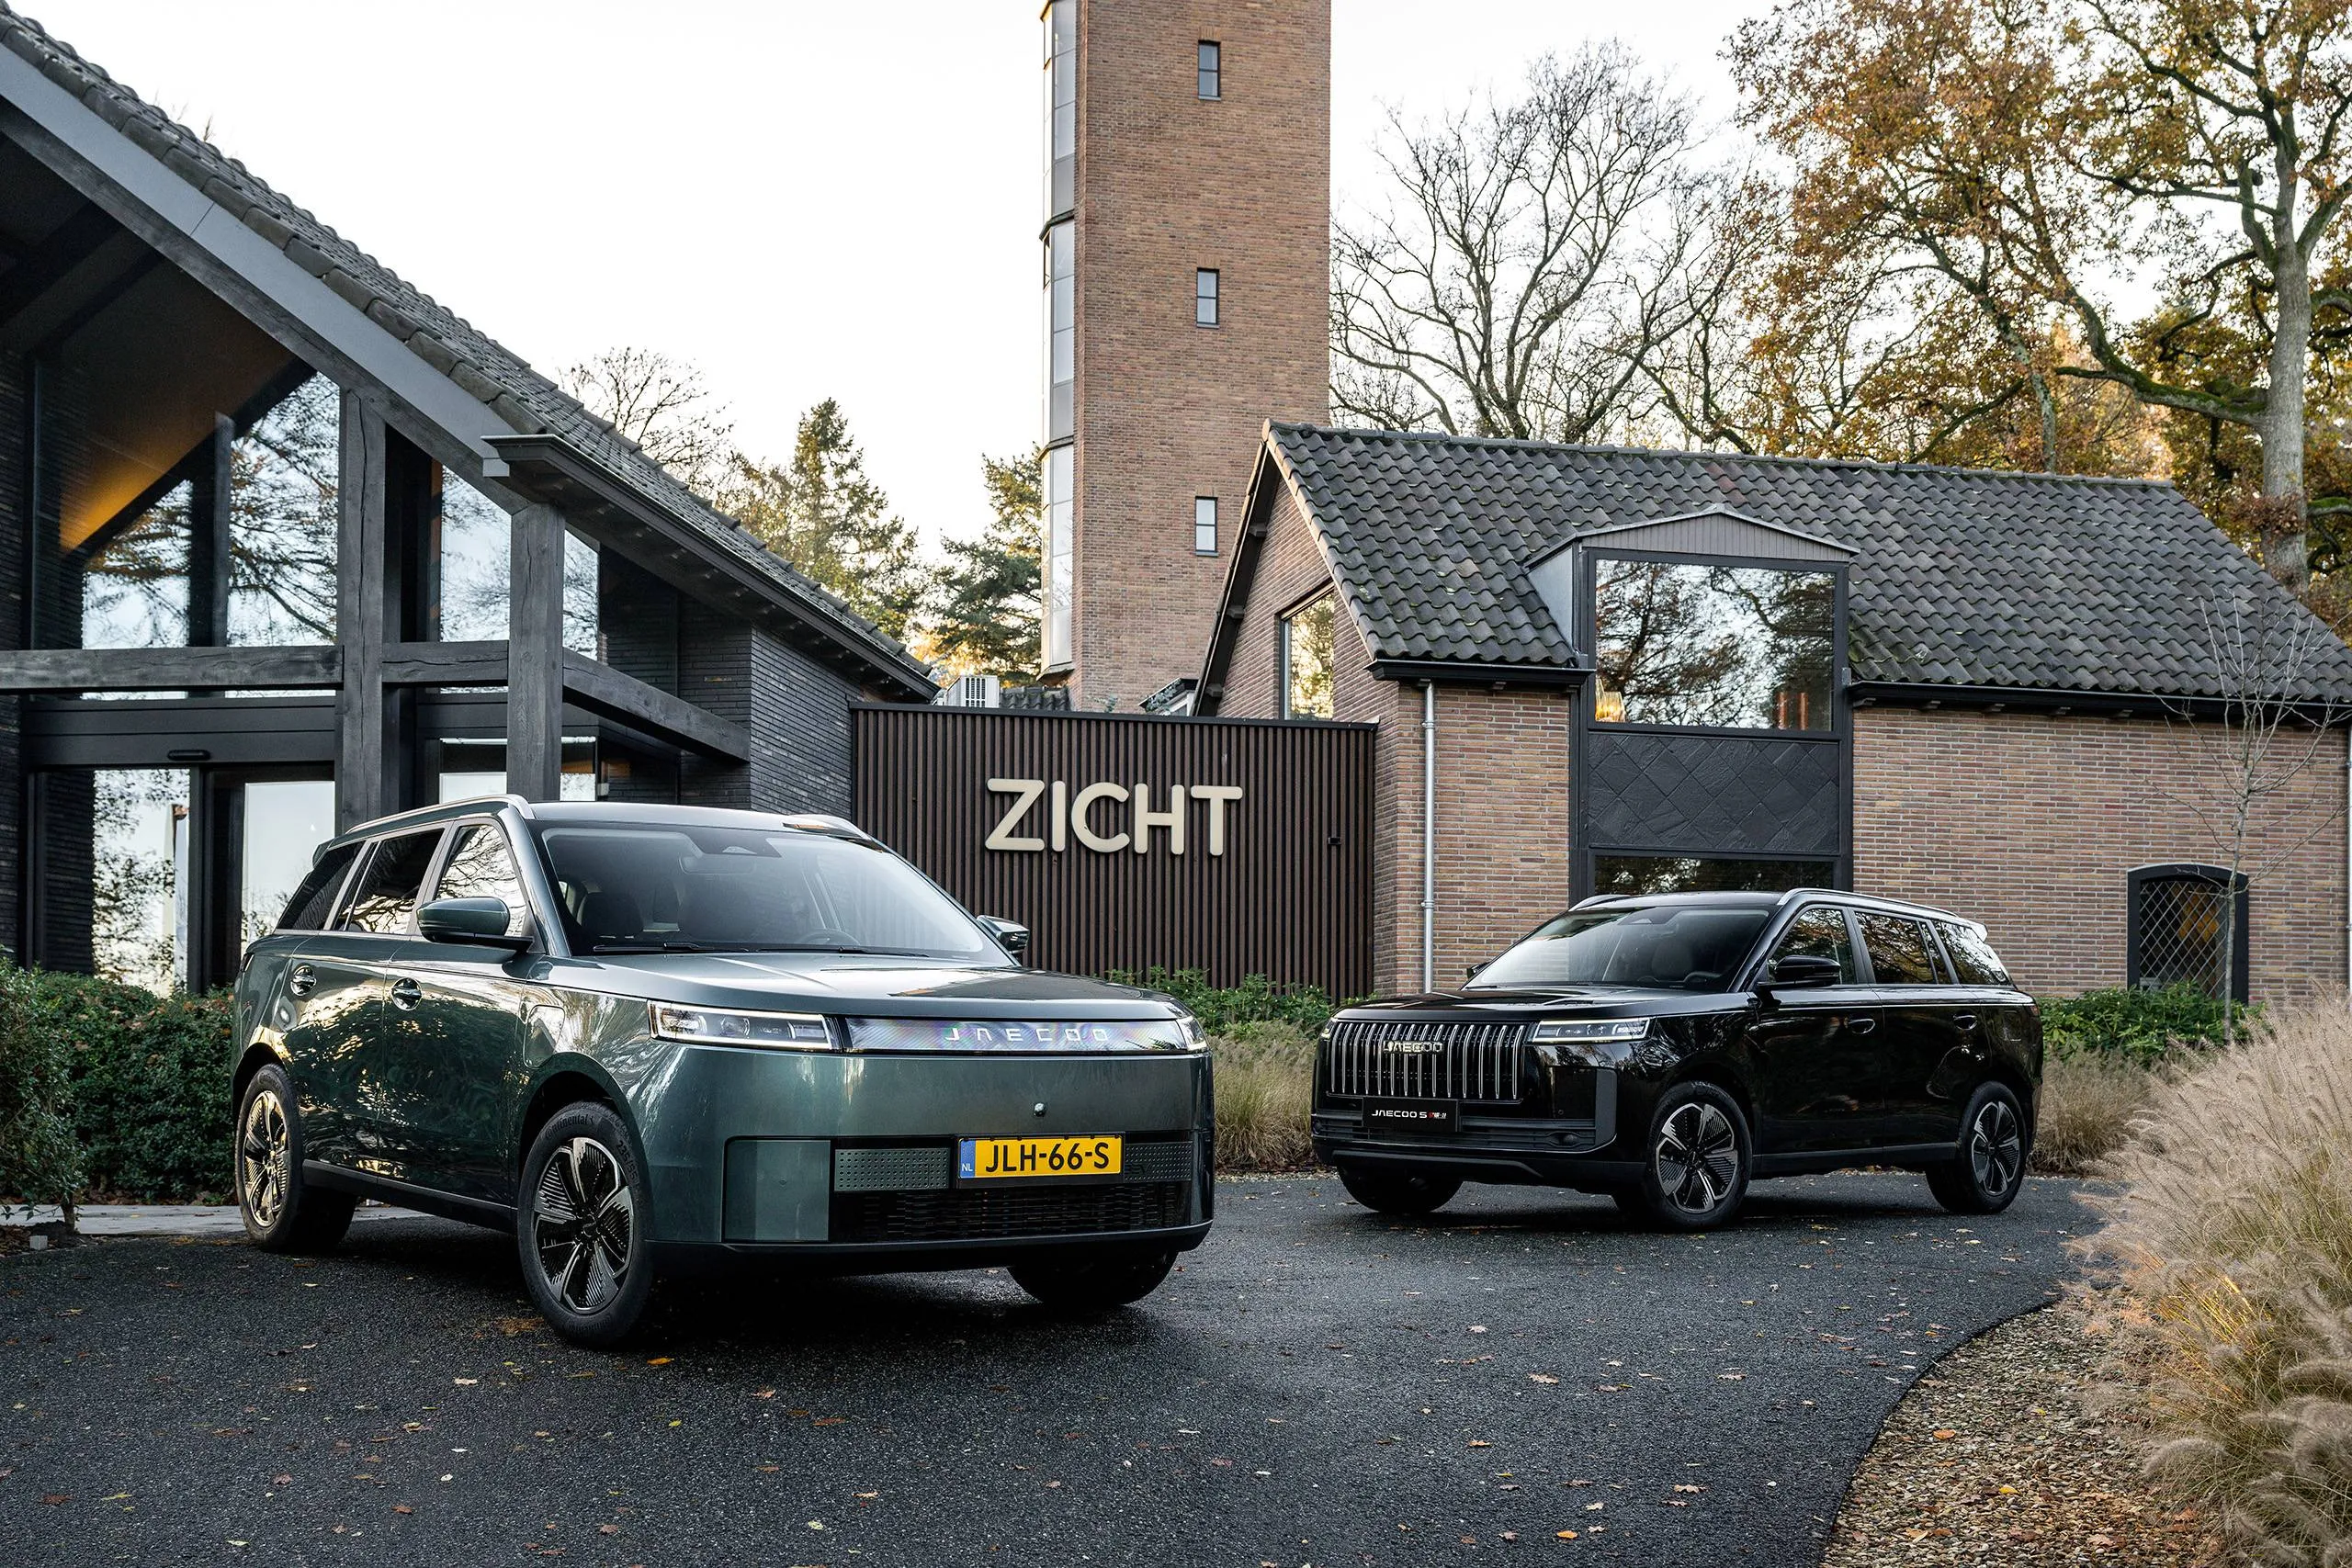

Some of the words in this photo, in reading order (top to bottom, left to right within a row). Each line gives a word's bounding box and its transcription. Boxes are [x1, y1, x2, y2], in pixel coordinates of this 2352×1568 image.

[985, 778, 1243, 856] ZICHT
[944, 1027, 1108, 1042] JAECOO
[1383, 1040, 1443, 1053] JAECOO
[1371, 1110, 1418, 1119] JAECOO
[545, 1114, 589, 1140] Continental
[986, 1142, 1109, 1173] JLH-66-S
[962, 1163, 973, 1171] NL
